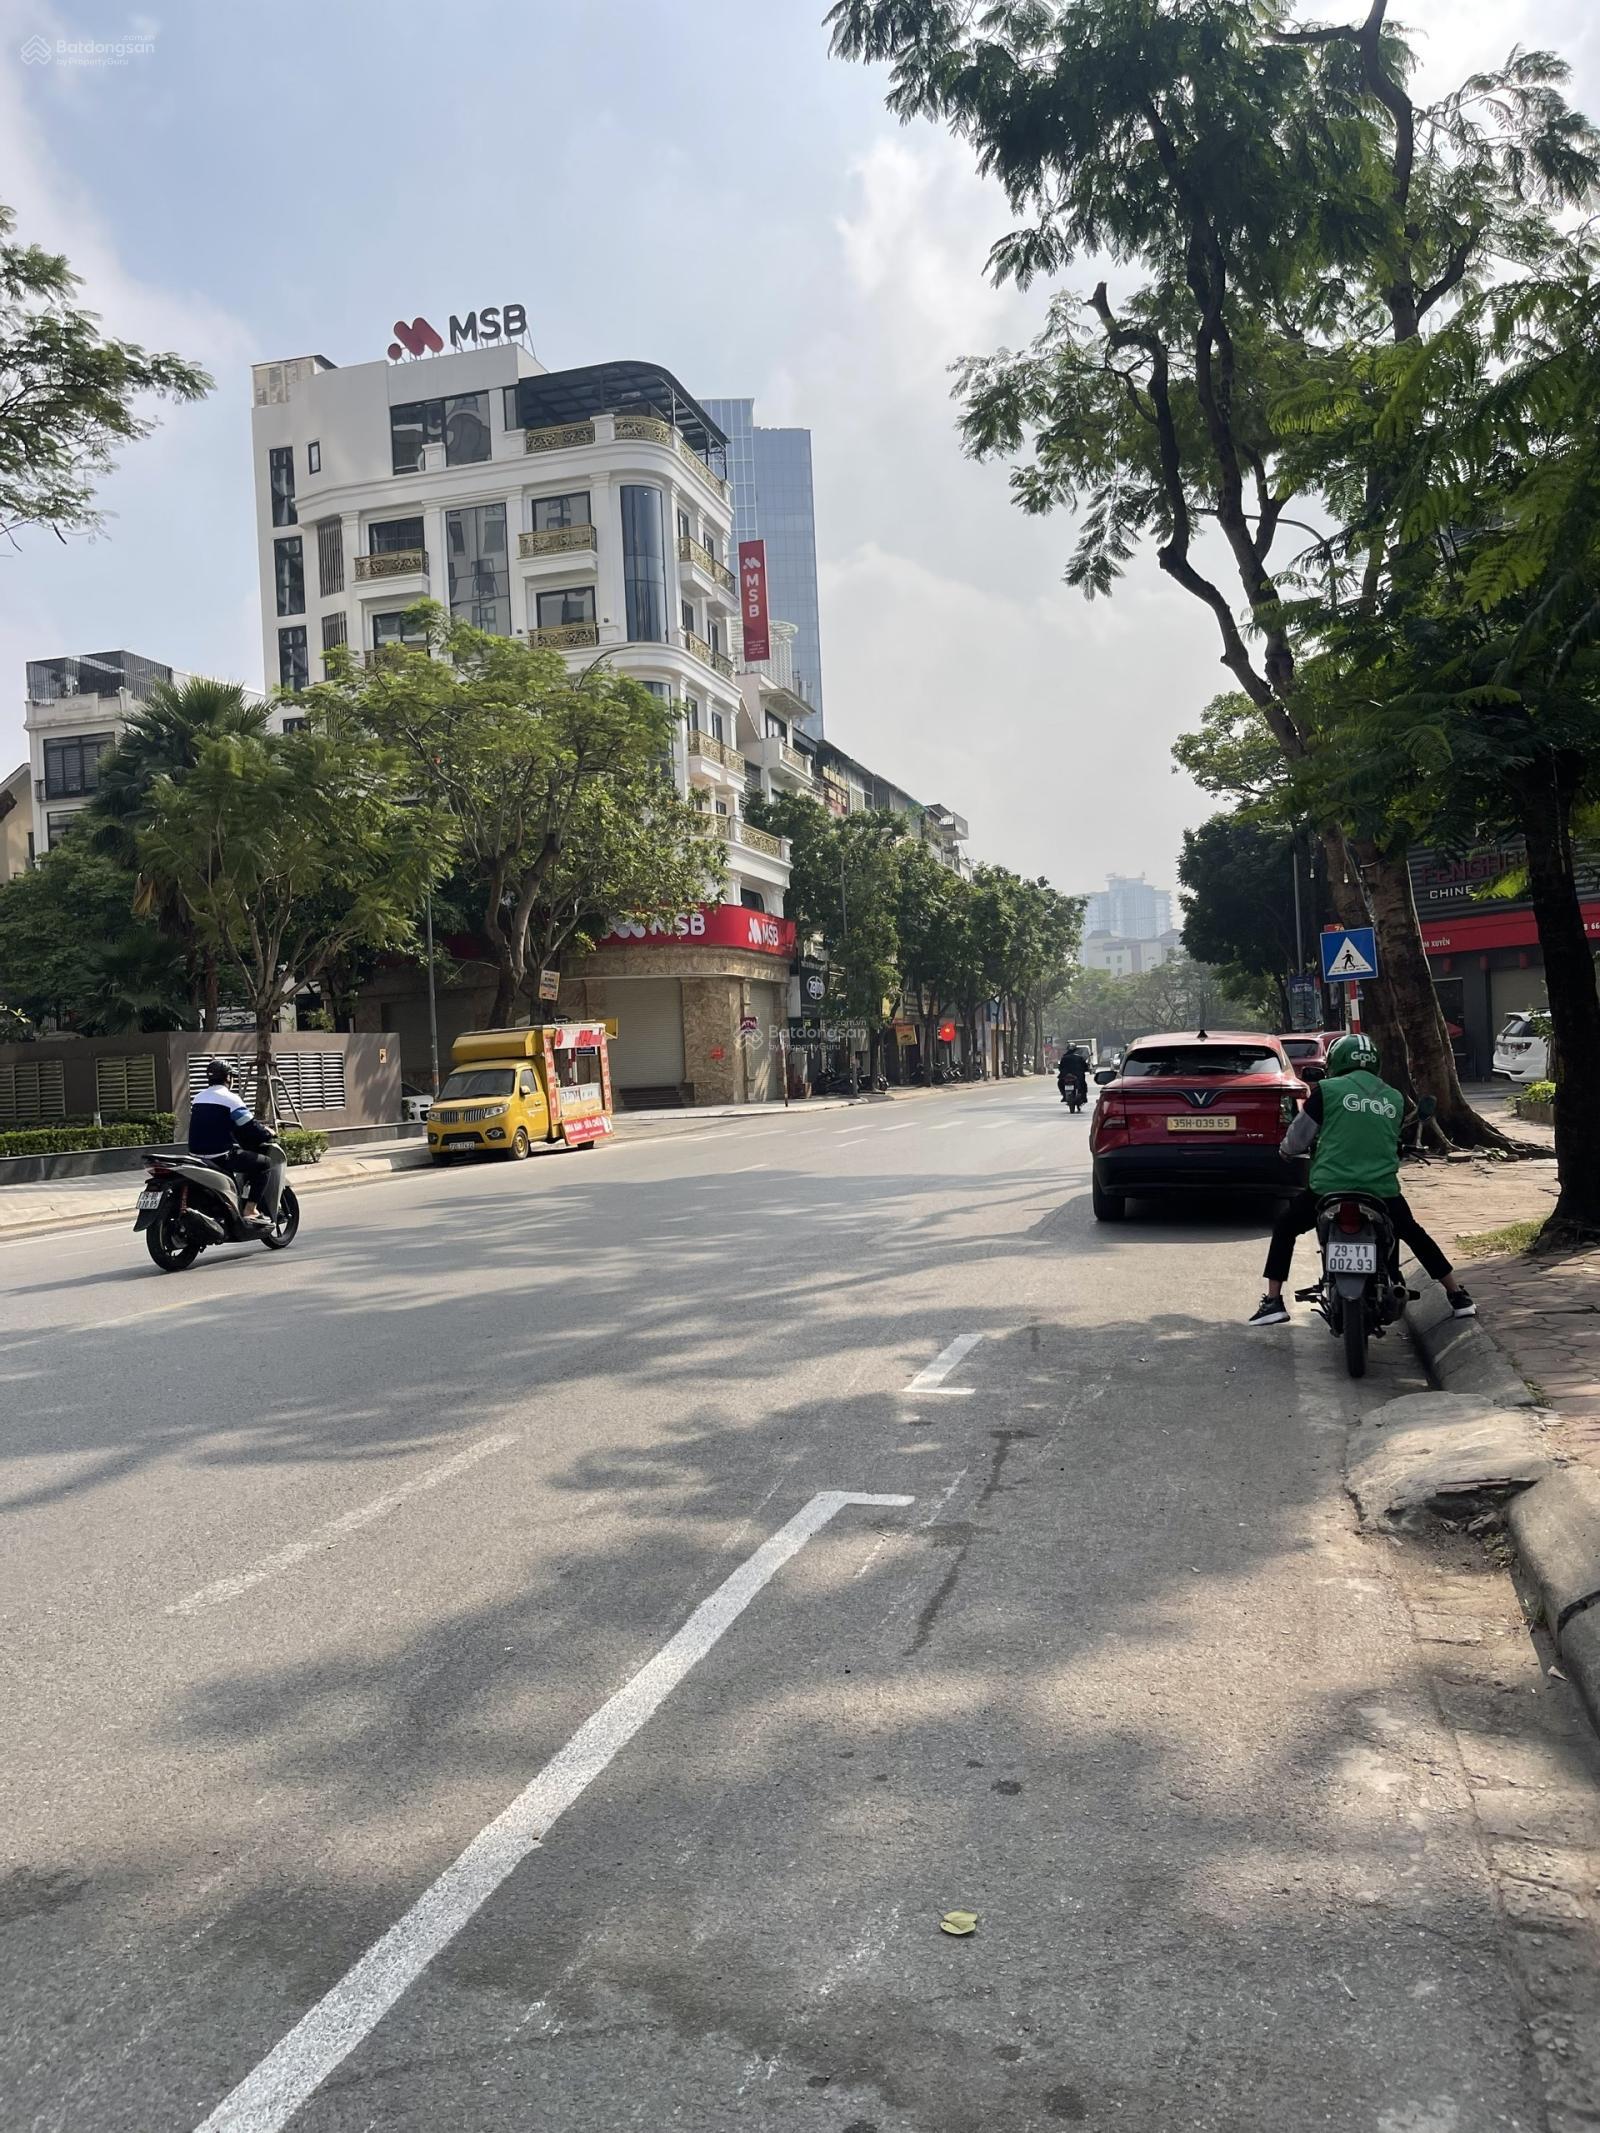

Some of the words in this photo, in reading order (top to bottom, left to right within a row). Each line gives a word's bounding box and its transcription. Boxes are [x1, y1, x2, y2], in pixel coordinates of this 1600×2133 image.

[449, 304, 527, 347] MSB
[746, 573, 760, 618] MSB
[761, 922, 779, 947] MSB
[1350, 1051, 1377, 1063] Grab
[1342, 1093, 1397, 1119] Grab
[1329, 1258, 1373, 1271] 002.93
